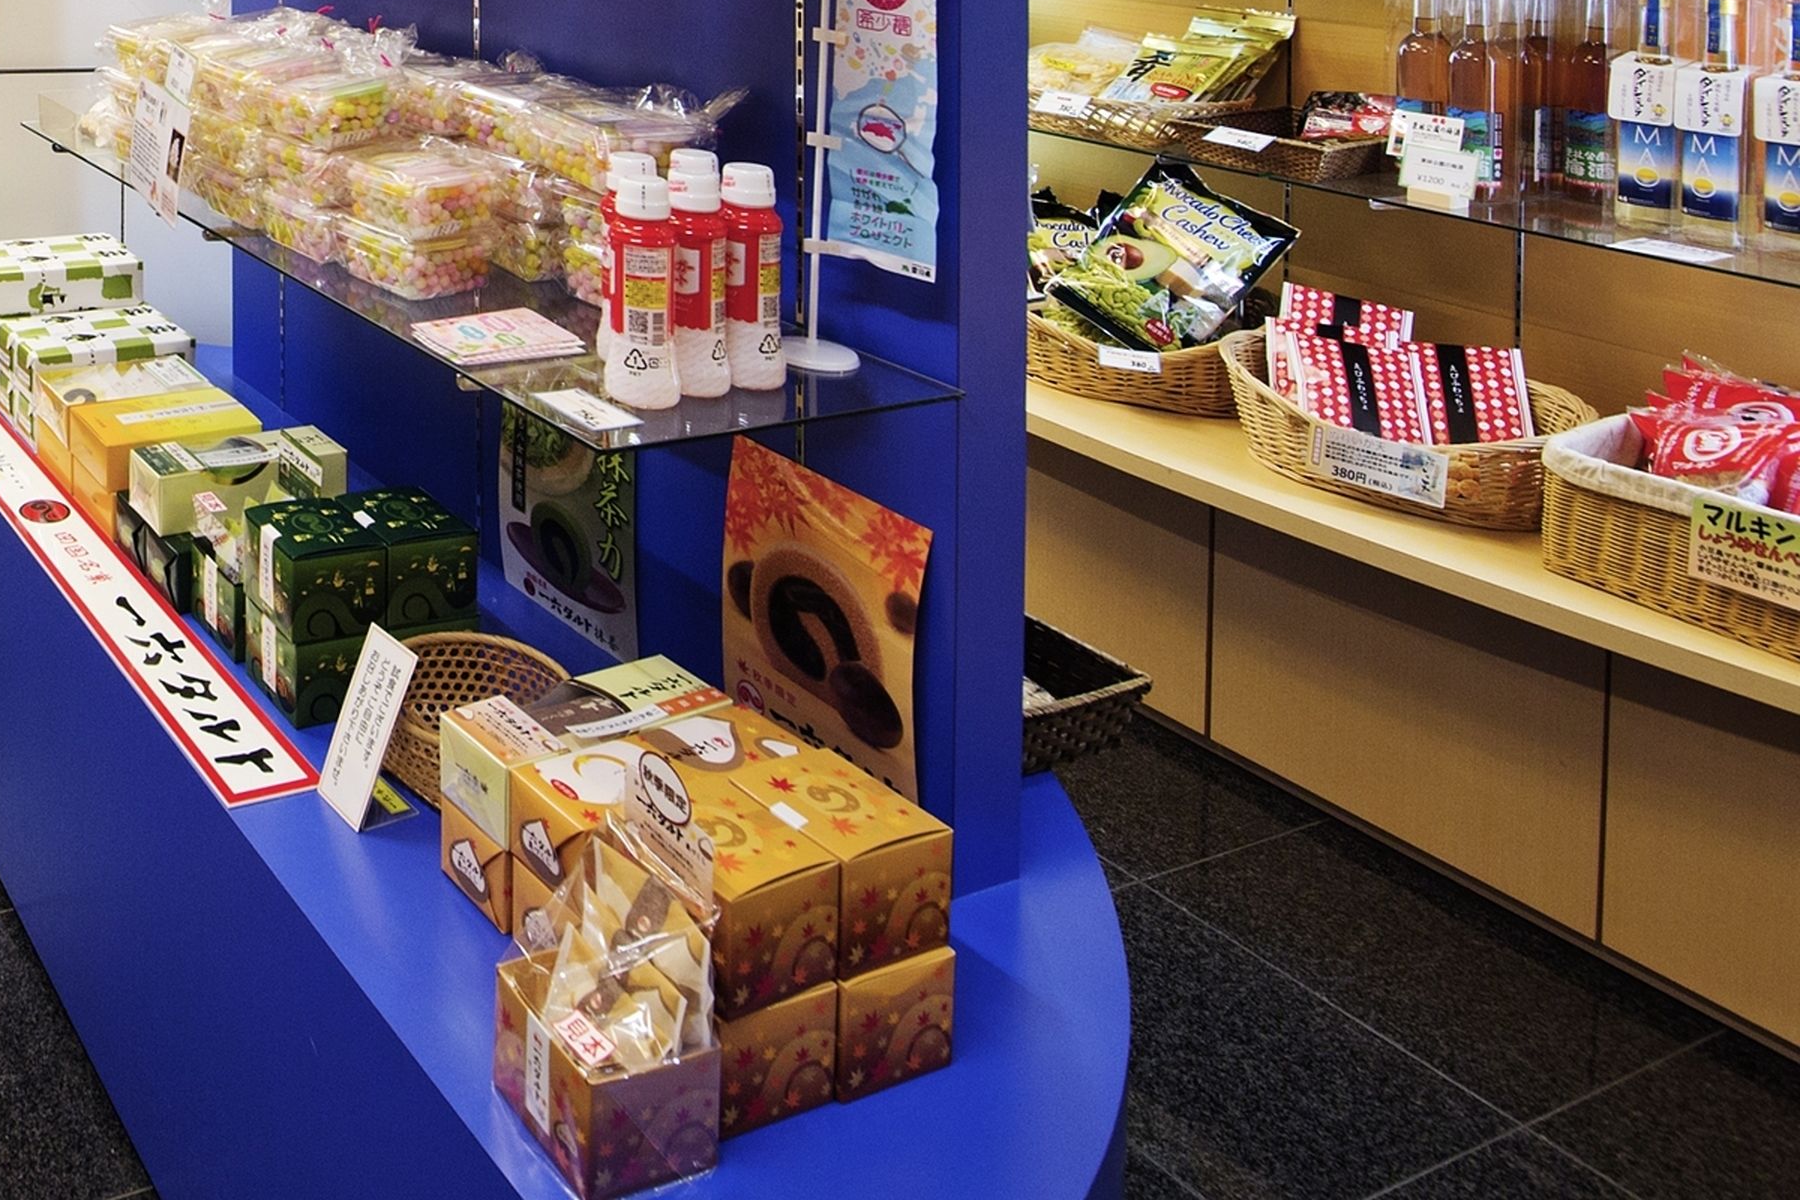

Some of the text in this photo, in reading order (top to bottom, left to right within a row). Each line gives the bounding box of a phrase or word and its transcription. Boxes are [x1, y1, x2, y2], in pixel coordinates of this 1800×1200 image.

[857, 8, 911, 36] 希少糖
[850, 212, 913, 233] ホワイトバレー
[850, 225, 912, 248] プロジェクト
[1162, 205, 1230, 251] Cashew
[1219, 214, 1272, 252] Chees
[1332, 465, 1366, 484] 380円
[1703, 504, 1795, 544] マルキン
[54, 531, 113, 585] 四国名菓
[538, 590, 592, 637] 一六タルト
[115, 596, 273, 773] 一六タルト
[643, 764, 687, 814] 秋季限定
[561, 1018, 608, 1057] 見本
